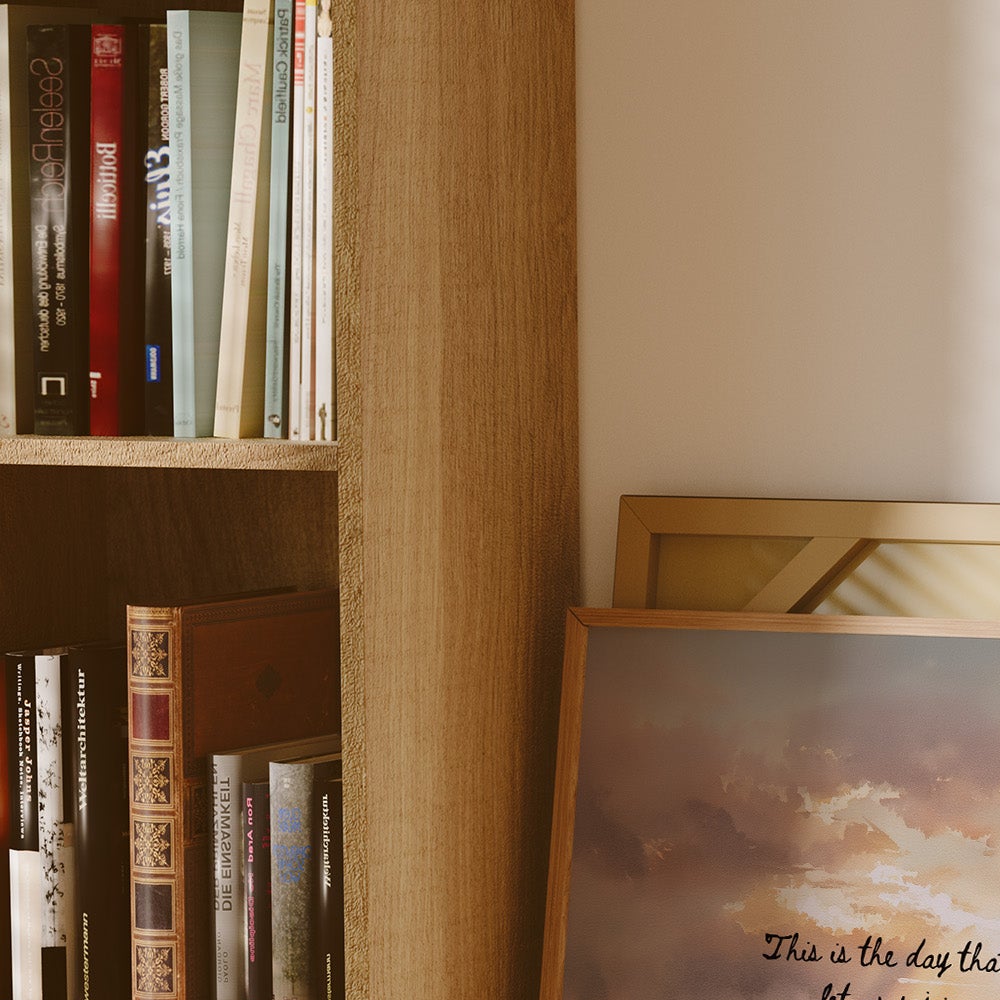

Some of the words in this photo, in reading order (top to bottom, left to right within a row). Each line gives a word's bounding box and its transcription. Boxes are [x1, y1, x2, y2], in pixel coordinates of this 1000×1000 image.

[24, 700, 32, 752] Jasper
[76, 668, 87, 812] Weltarchitektur
[25, 756, 33, 803] Johns
[762, 933, 822, 963] This
[829, 943, 851, 965] is
[858, 937, 897, 968] the
[905, 939, 952, 974] day
